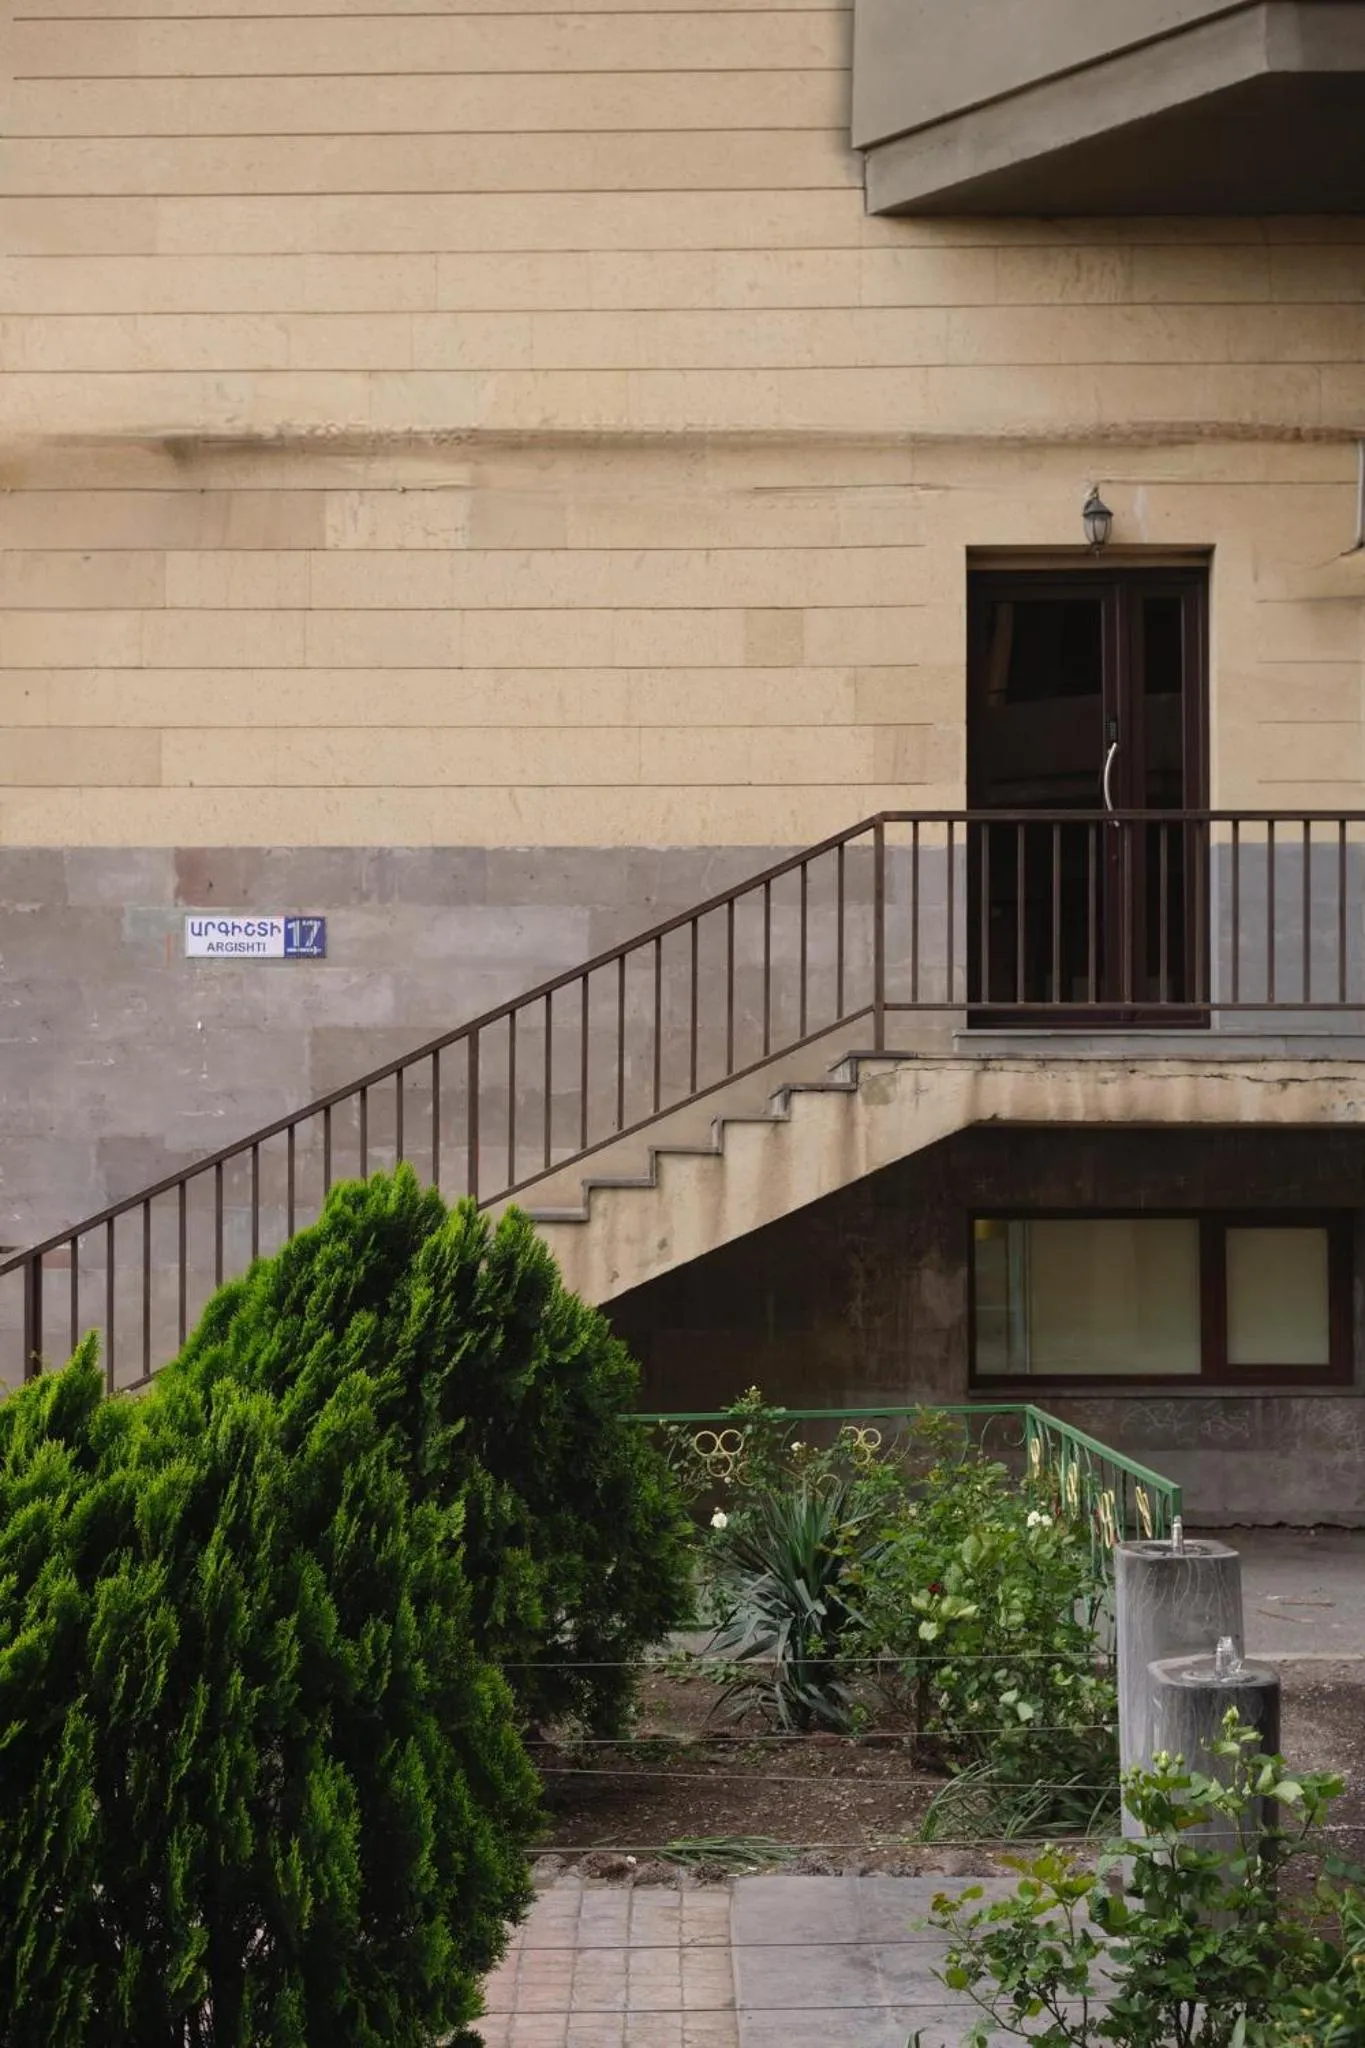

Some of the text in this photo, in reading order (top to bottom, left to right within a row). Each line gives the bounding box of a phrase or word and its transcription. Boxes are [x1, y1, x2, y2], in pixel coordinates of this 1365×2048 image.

[190, 921, 282, 937] ԱՐԳԻՇՏԻ
[288, 919, 322, 949] 17
[206, 941, 267, 953] ARGISHTI
